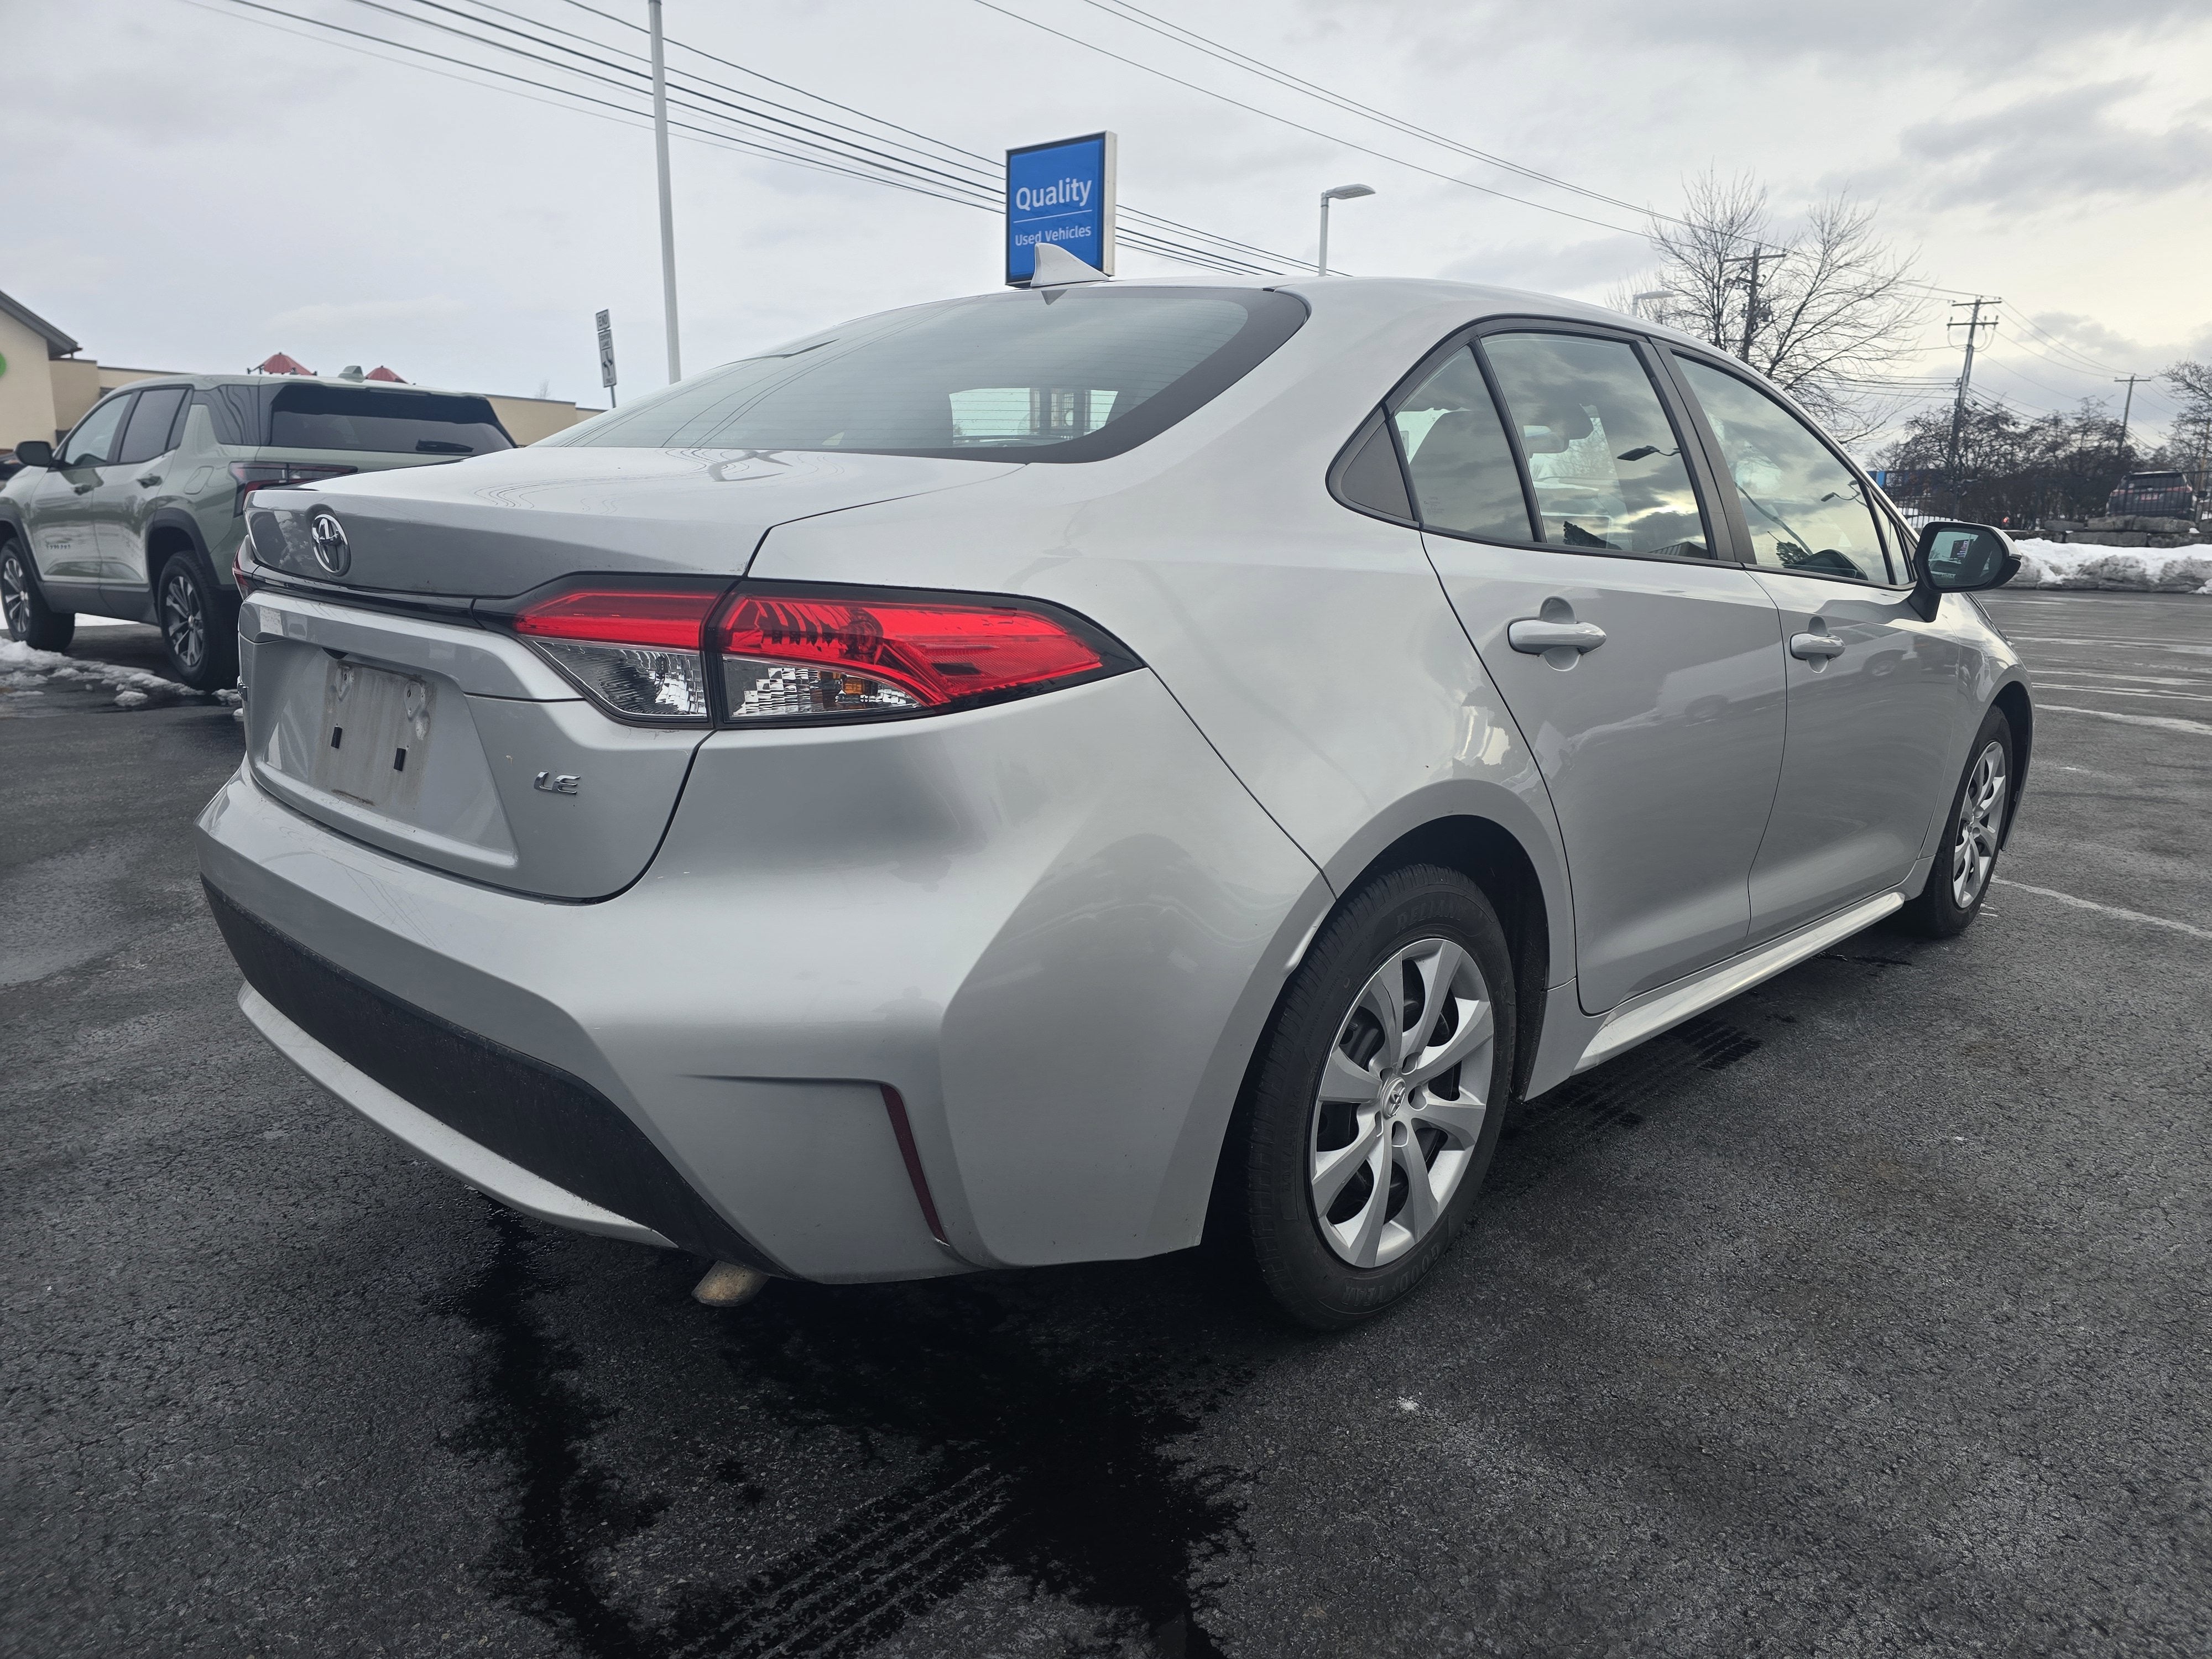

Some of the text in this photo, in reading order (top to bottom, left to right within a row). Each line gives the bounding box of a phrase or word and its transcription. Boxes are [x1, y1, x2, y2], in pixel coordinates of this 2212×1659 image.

[1016, 178, 1092, 211] Quality
[1015, 226, 1092, 246] Used Vehicles
[534, 771, 580, 795] LE
